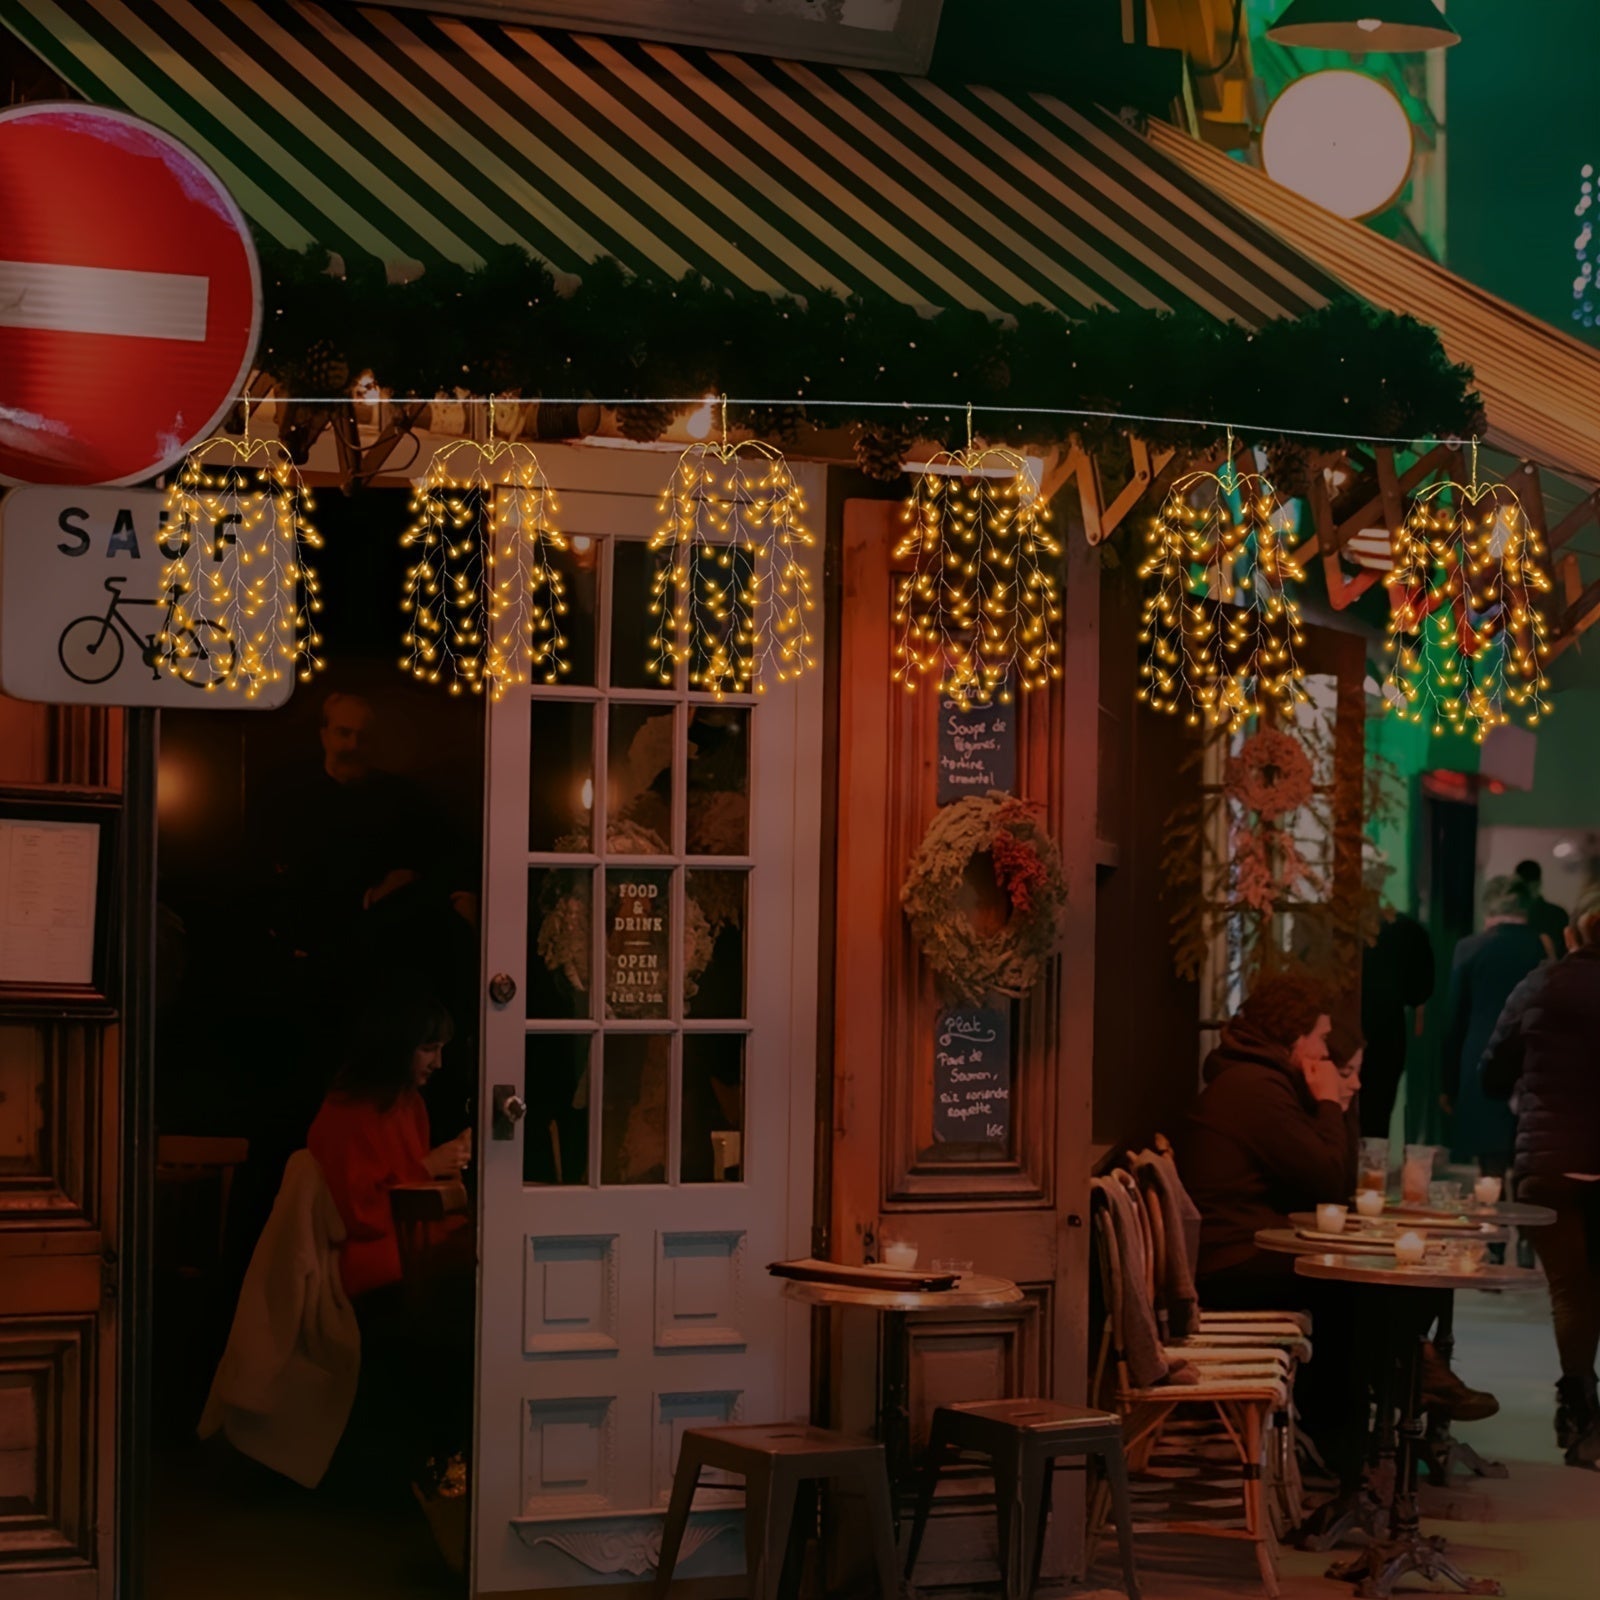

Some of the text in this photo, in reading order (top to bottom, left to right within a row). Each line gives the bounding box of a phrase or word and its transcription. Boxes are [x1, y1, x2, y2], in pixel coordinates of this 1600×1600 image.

[57, 506, 243, 562] SAUF
[946, 715, 1007, 740] Soupe de
[618, 883, 659, 899] FOOD
[632, 900, 644, 915] &
[614, 917, 663, 932] DRINK
[617, 954, 659, 969] OPEN
[616, 971, 660, 986] DAILY
[944, 1015, 982, 1034] Plat
[969, 1048, 984, 1062] de
